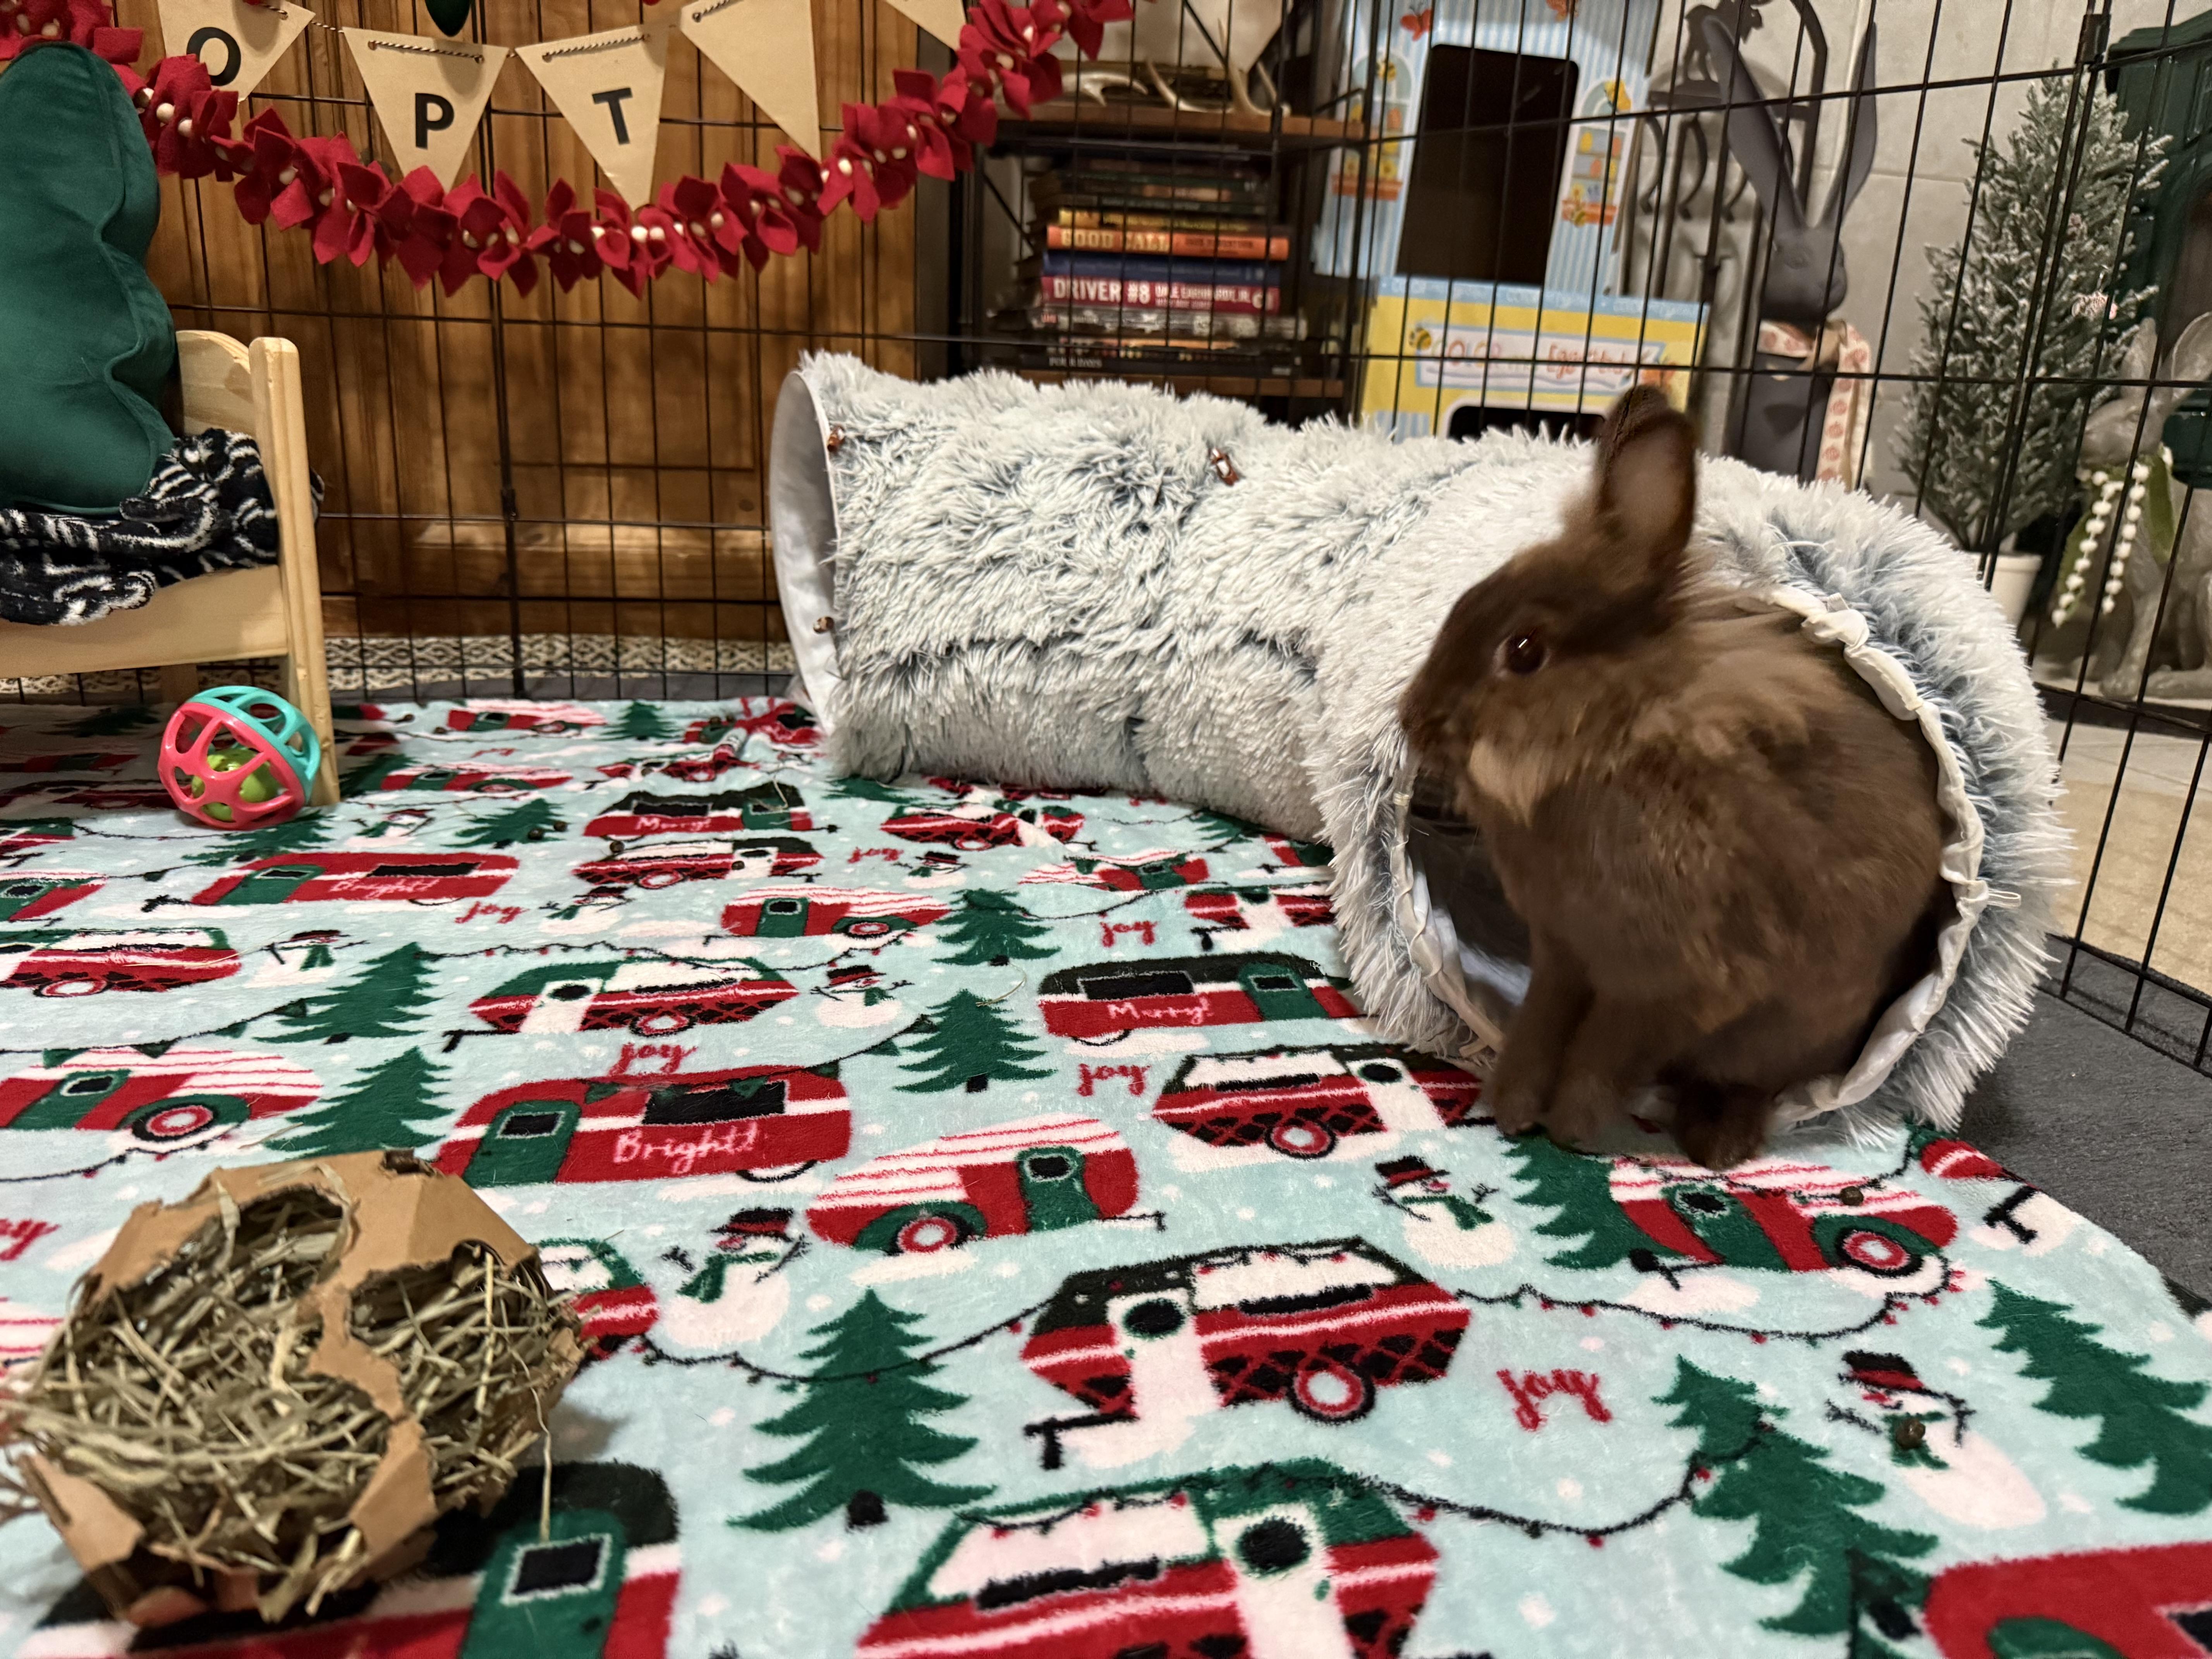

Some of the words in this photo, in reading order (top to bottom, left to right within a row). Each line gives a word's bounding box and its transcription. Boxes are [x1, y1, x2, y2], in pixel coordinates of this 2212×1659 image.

[1053, 277, 1121, 303] DRIVER
[1127, 280, 1151, 304] #8
[454, 901, 530, 924] joy
[1100, 921, 1158, 947] joy
[608, 1042, 698, 1076] joy
[1077, 1063, 1152, 1097] joy
[1496, 1369, 1614, 1432] joy
